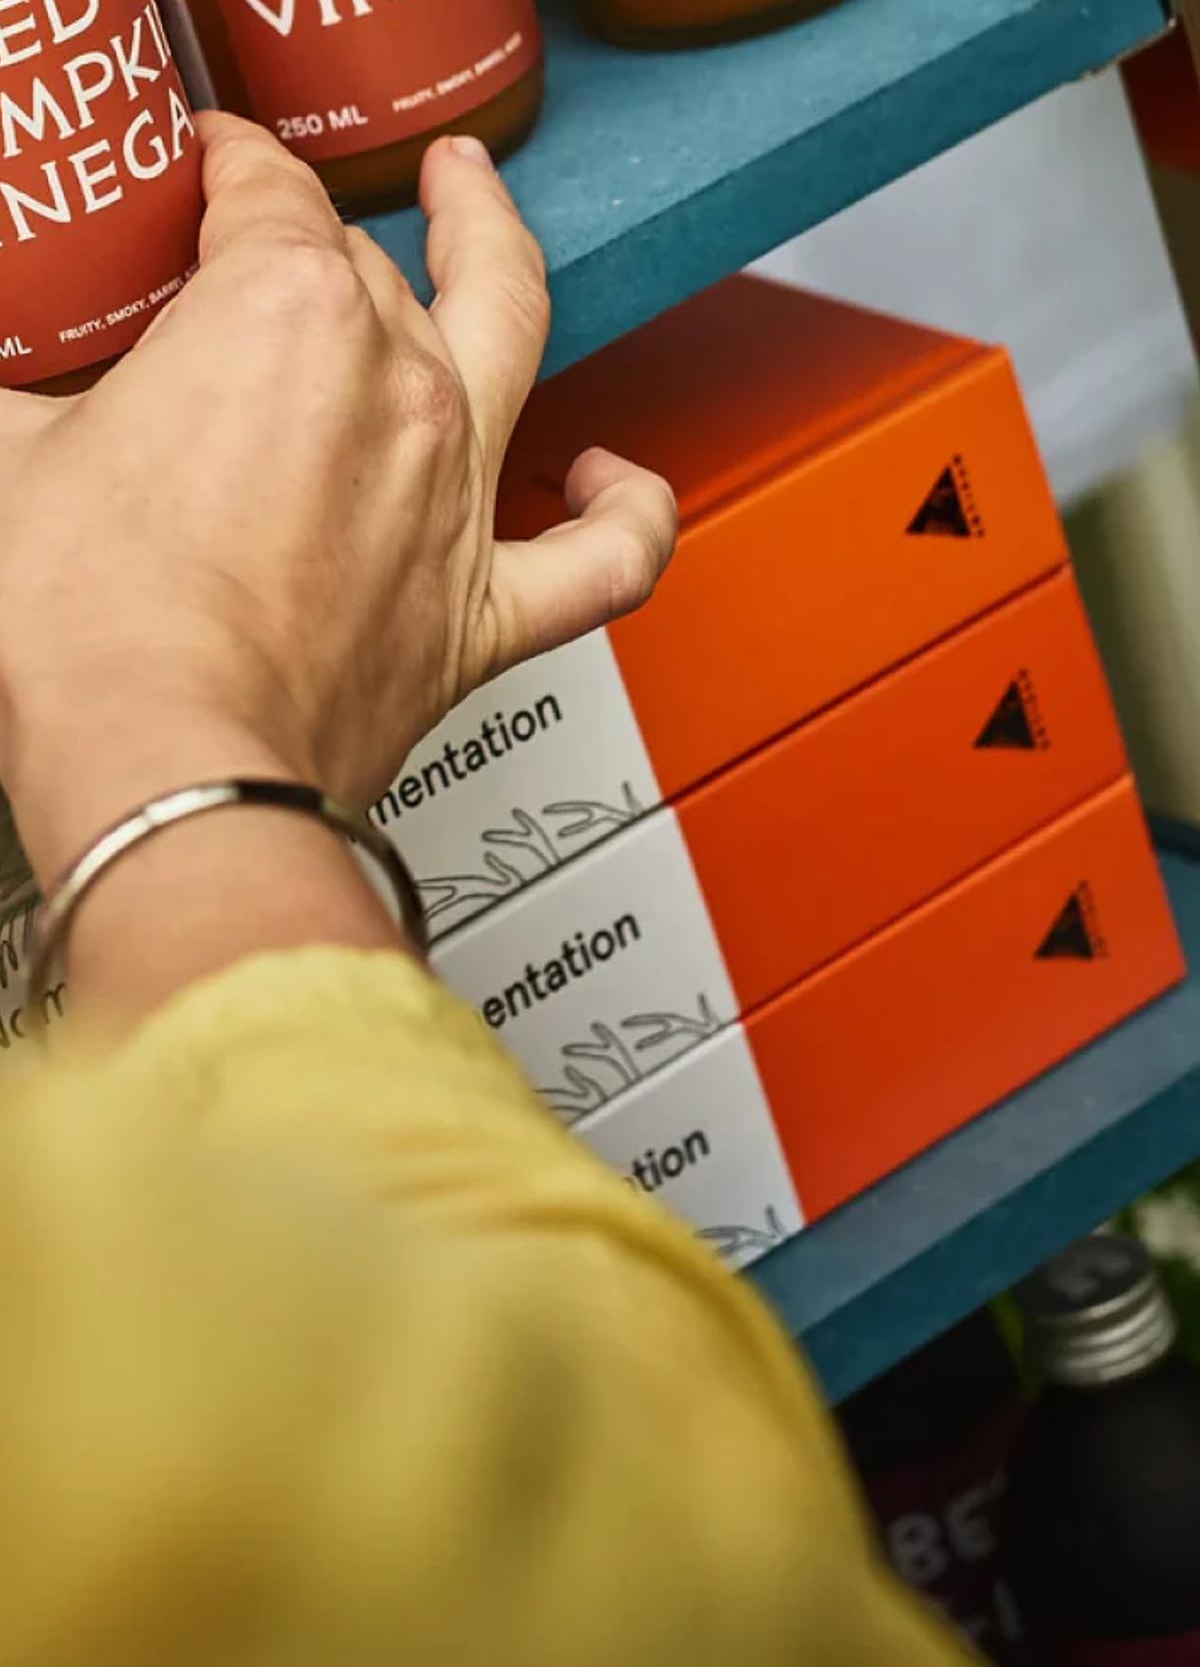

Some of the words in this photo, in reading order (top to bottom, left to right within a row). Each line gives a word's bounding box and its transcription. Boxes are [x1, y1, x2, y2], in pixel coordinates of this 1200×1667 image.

[277, 115, 323, 140] 250
[328, 105, 368, 129] ML
[58, 318, 106, 343] FRUITY,
[106, 298, 150, 325] SMOKY,
[477, 911, 641, 1030] entation
[627, 1127, 711, 1194] tion
